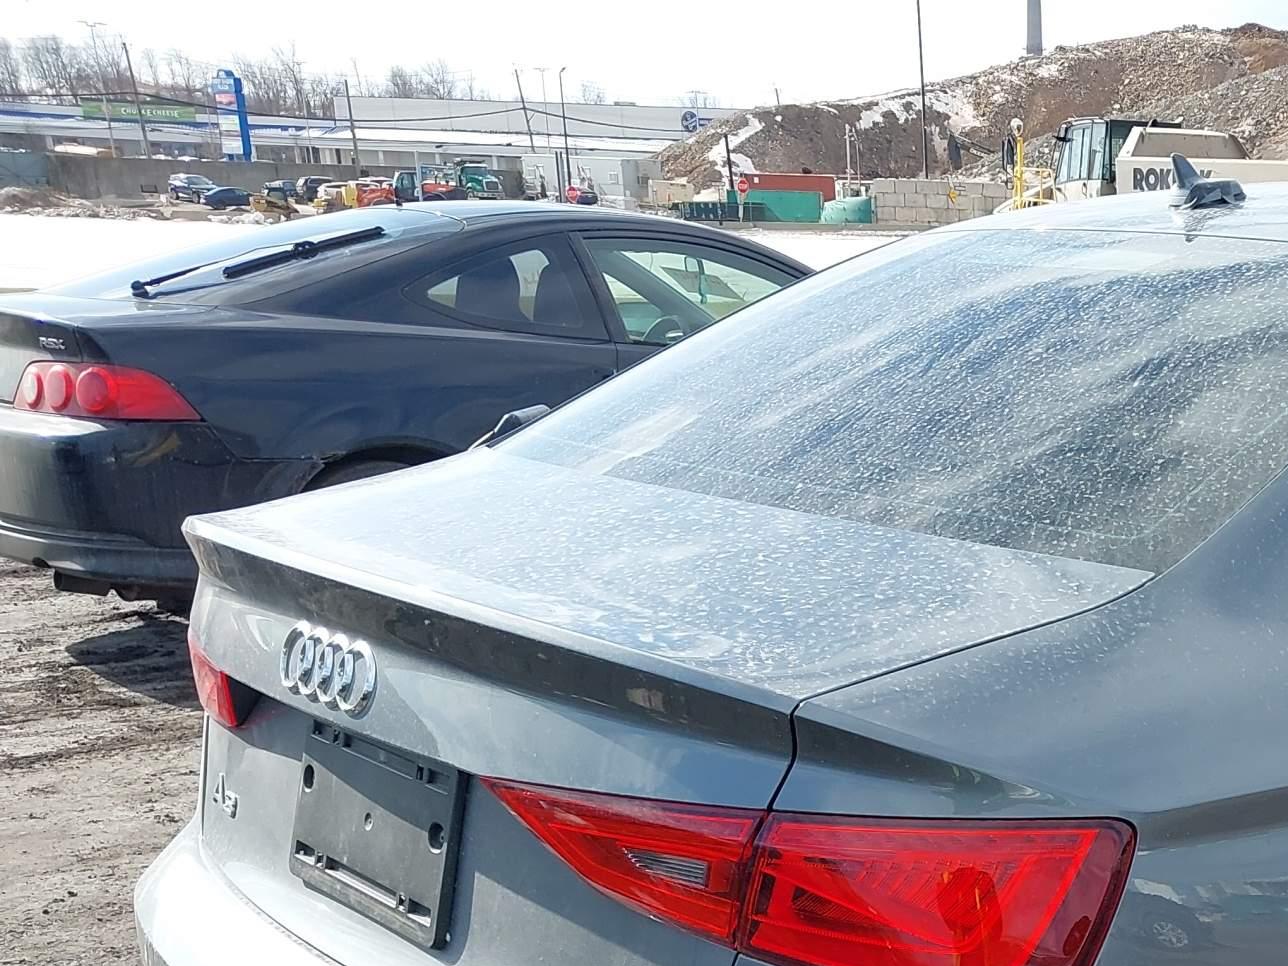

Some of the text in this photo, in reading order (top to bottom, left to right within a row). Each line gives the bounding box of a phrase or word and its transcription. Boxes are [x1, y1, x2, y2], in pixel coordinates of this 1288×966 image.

[121, 107, 146, 115] CHUK
[38, 336, 66, 350] RSX
[212, 772, 240, 820] A3
